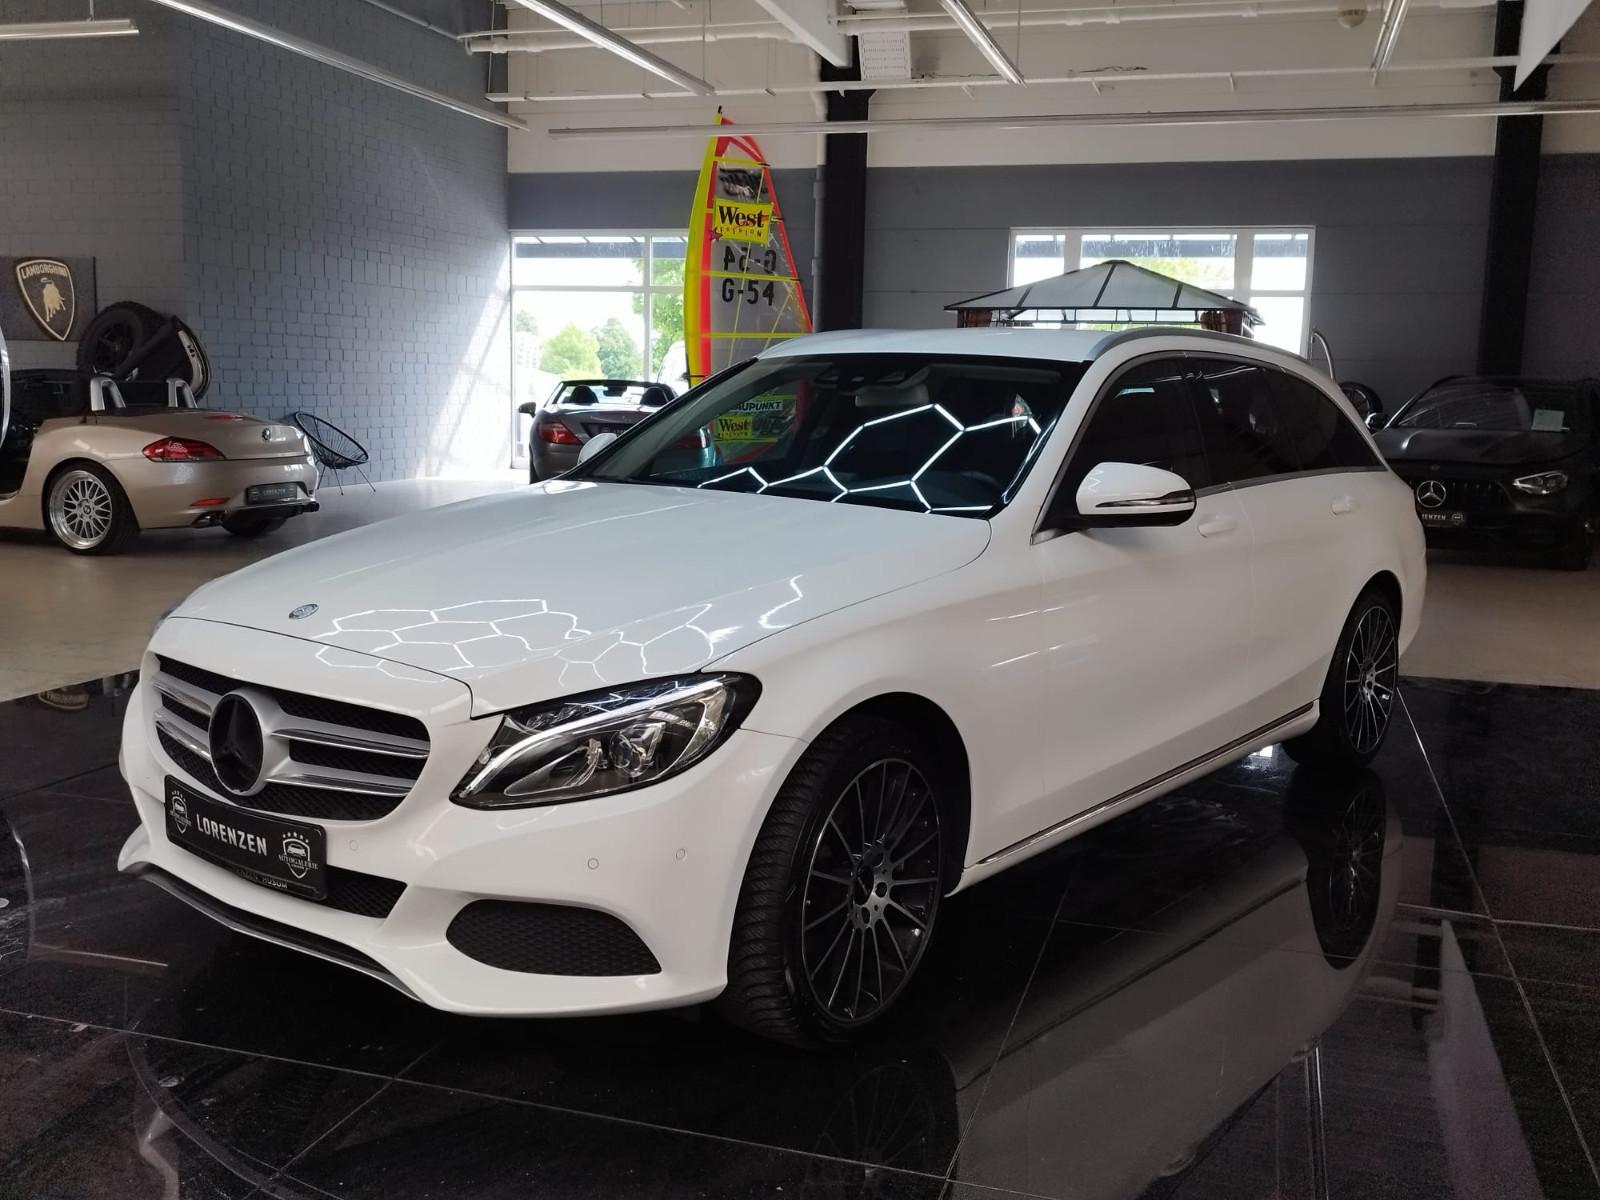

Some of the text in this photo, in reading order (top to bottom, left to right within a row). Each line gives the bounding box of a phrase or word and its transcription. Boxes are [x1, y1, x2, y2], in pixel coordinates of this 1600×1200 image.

[718, 205, 766, 228] West
[21, 263, 68, 280] LAMBORGHINI
[721, 278, 775, 306] G-54
[735, 400, 782, 411] AUPUNKT
[719, 418, 750, 432] West
[196, 813, 268, 857] LORENZEN
